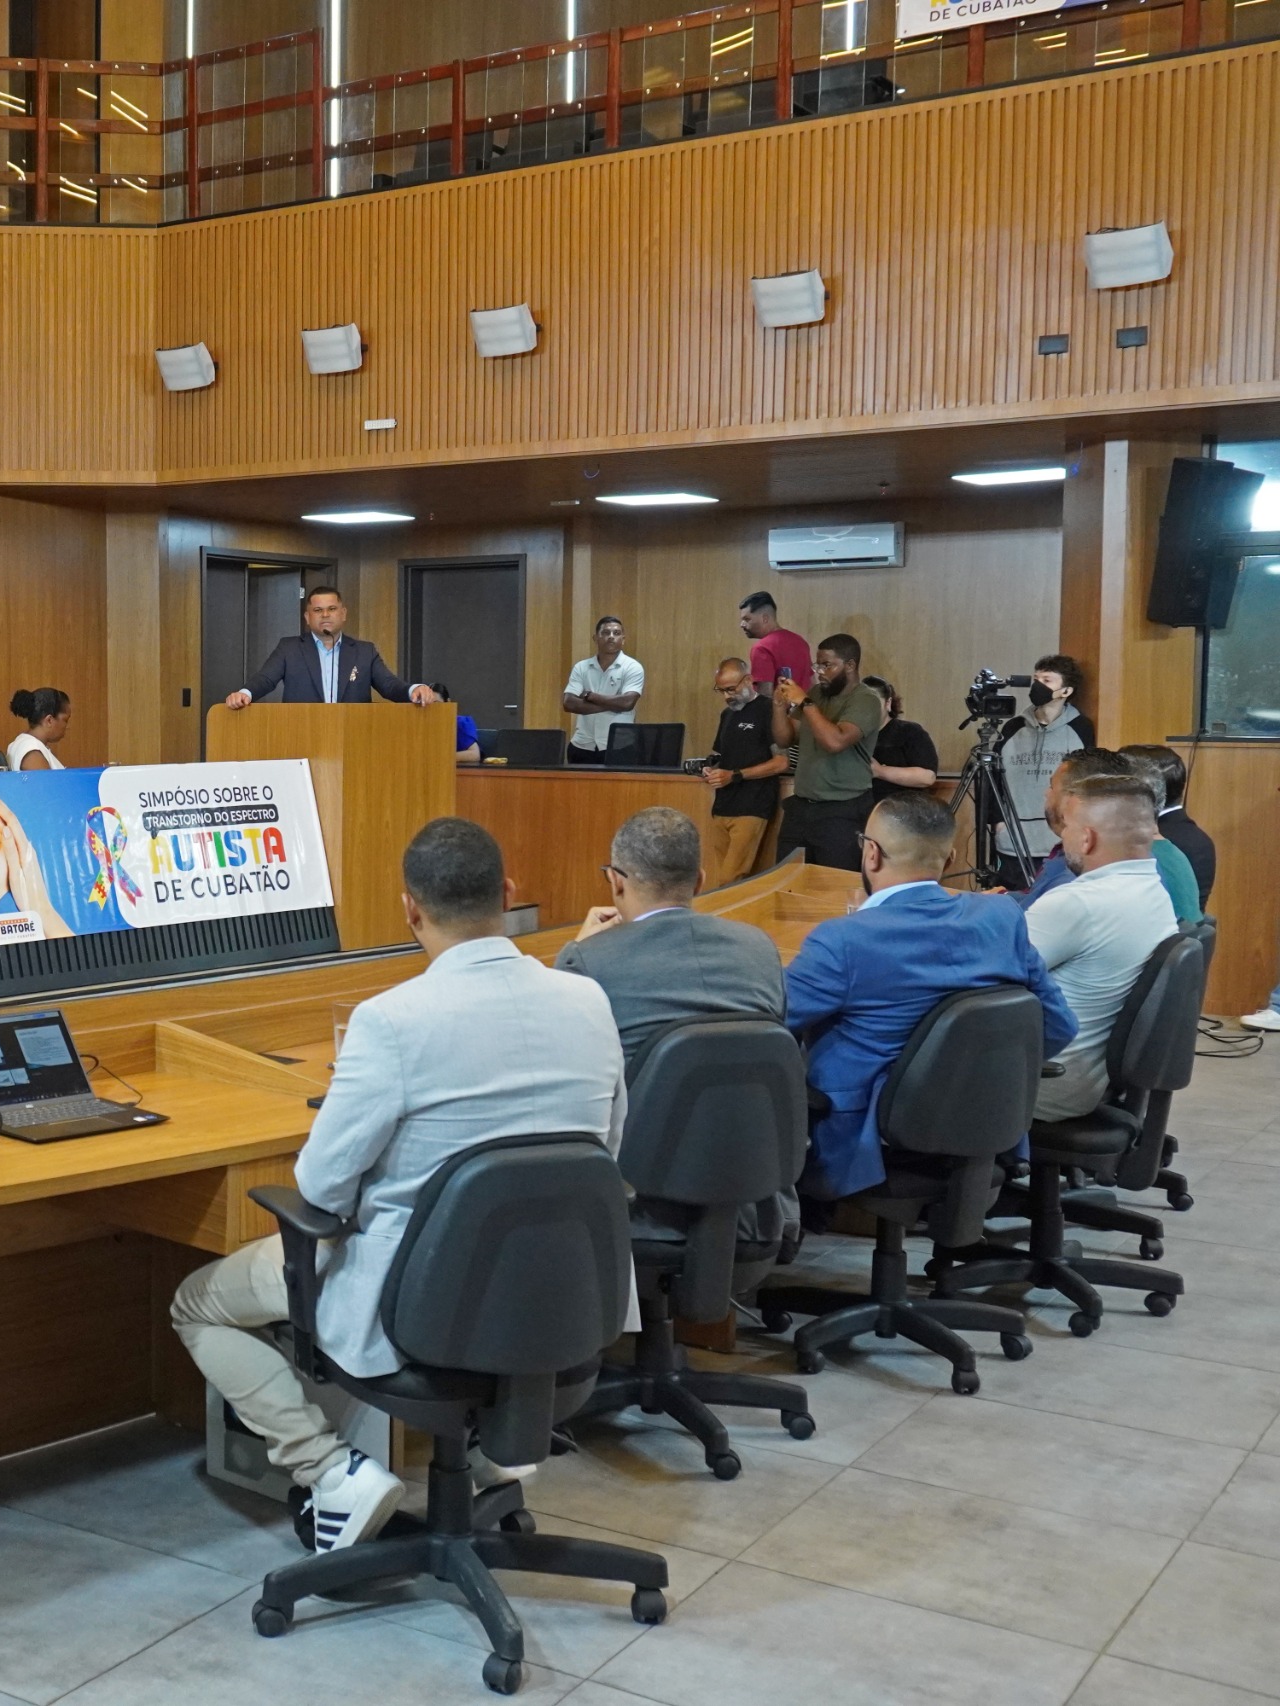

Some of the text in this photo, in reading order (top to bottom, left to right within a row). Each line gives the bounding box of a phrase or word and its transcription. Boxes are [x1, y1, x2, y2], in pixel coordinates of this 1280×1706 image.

[929, 8, 951, 22] DE
[138, 785, 274, 808] SIMPÓSIO SOBRE O
[145, 808, 276, 828] TRANSTORNO DO ESPECTRO
[148, 826, 287, 875] AUTISTA
[153, 864, 291, 904] DE CUBATÃO
[0, 921, 36, 935] BATORÉ
